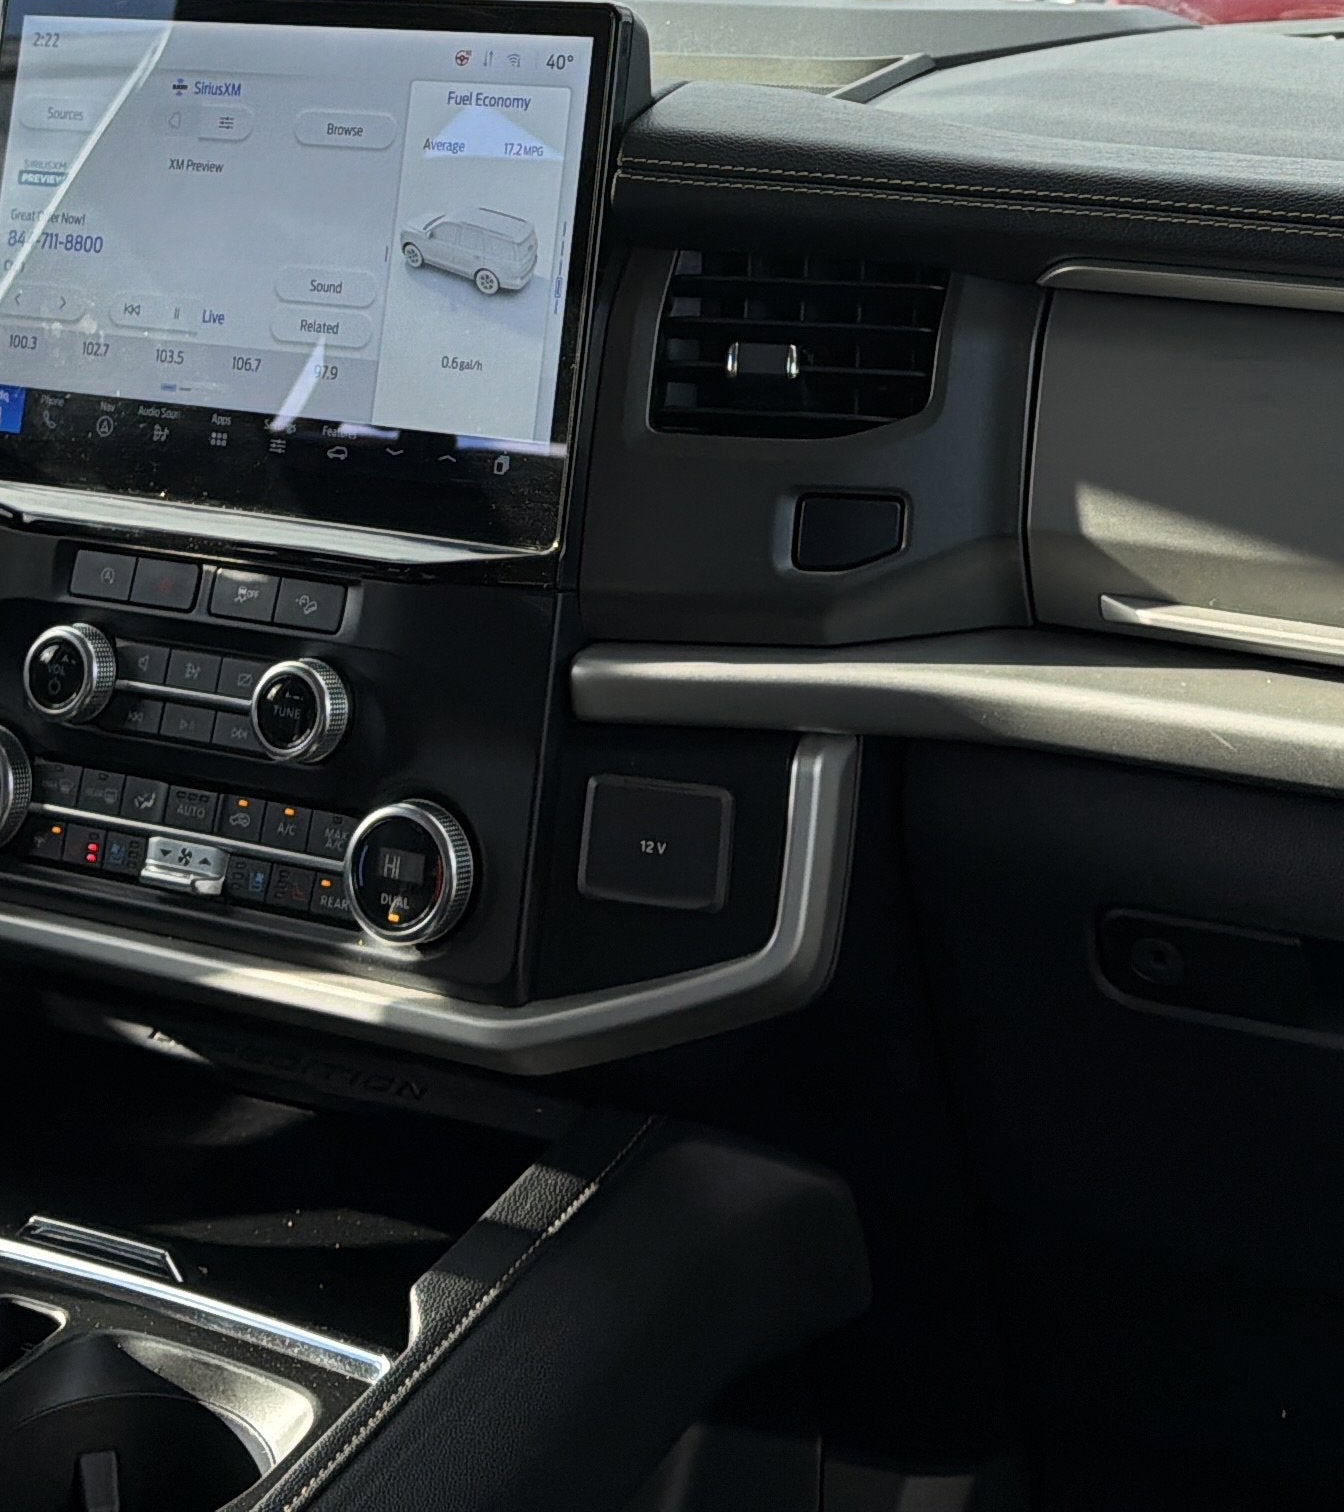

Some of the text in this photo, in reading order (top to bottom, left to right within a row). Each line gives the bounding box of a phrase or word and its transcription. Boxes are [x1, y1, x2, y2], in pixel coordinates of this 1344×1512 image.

[33, 32, 60, 48] 2:22
[546, 53, 574, 70] 40°
[193, 80, 242, 97] SiriusXM
[447, 90, 532, 111] Fuel Economy
[47, 106, 84, 122] Sources
[326, 122, 364, 137] Browse
[423, 138, 466, 154] Average
[168, 157, 225, 173] XM Preview
[11, 208, 38, 221] Great
[61, 212, 86, 226] Now!
[7, 230, 104, 254] 84-711-8800
[309, 279, 343, 294] Sound
[202, 309, 225, 324] Live
[299, 319, 340, 335] Related
[9, 334, 38, 350] 100.3
[82, 340, 110, 357] 102.7
[155, 348, 185, 365] 103.5
[231, 355, 261, 372] 106.7
[100, 401, 116, 413] Nav
[211, 414, 231, 428] Apps
[47, 662, 66, 676] VOL
[273, 704, 301, 719] TUNE
[176, 804, 205, 818] AUTO
[277, 822, 296, 836] A/C
[324, 827, 349, 841] MAX
[325, 838, 344, 851] A/C
[383, 853, 401, 880] HI
[320, 895, 349, 911] REAR
[380, 893, 410, 910] DUAL
